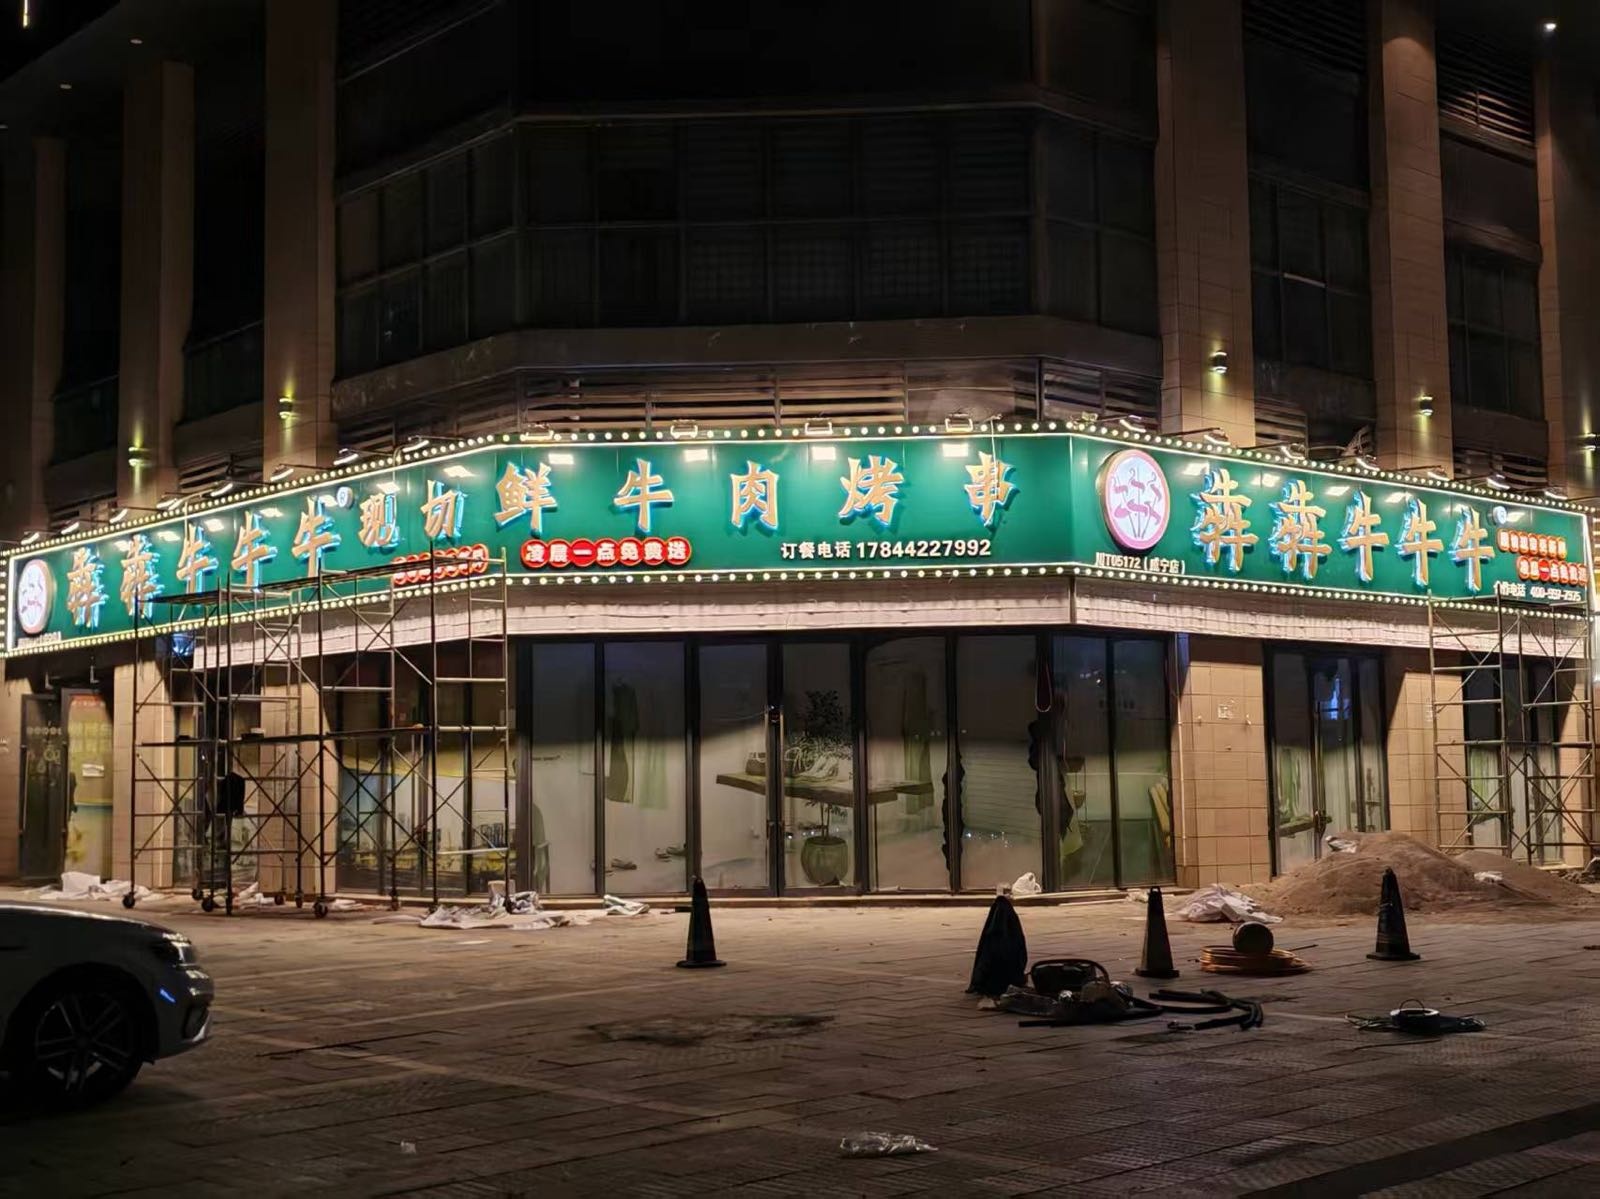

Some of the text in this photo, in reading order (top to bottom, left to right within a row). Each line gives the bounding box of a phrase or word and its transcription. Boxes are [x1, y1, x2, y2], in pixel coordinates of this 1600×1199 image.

[523, 539, 690, 564] 凌晨一点免费送
[781, 538, 991, 559] 订餐电话 17844227992
